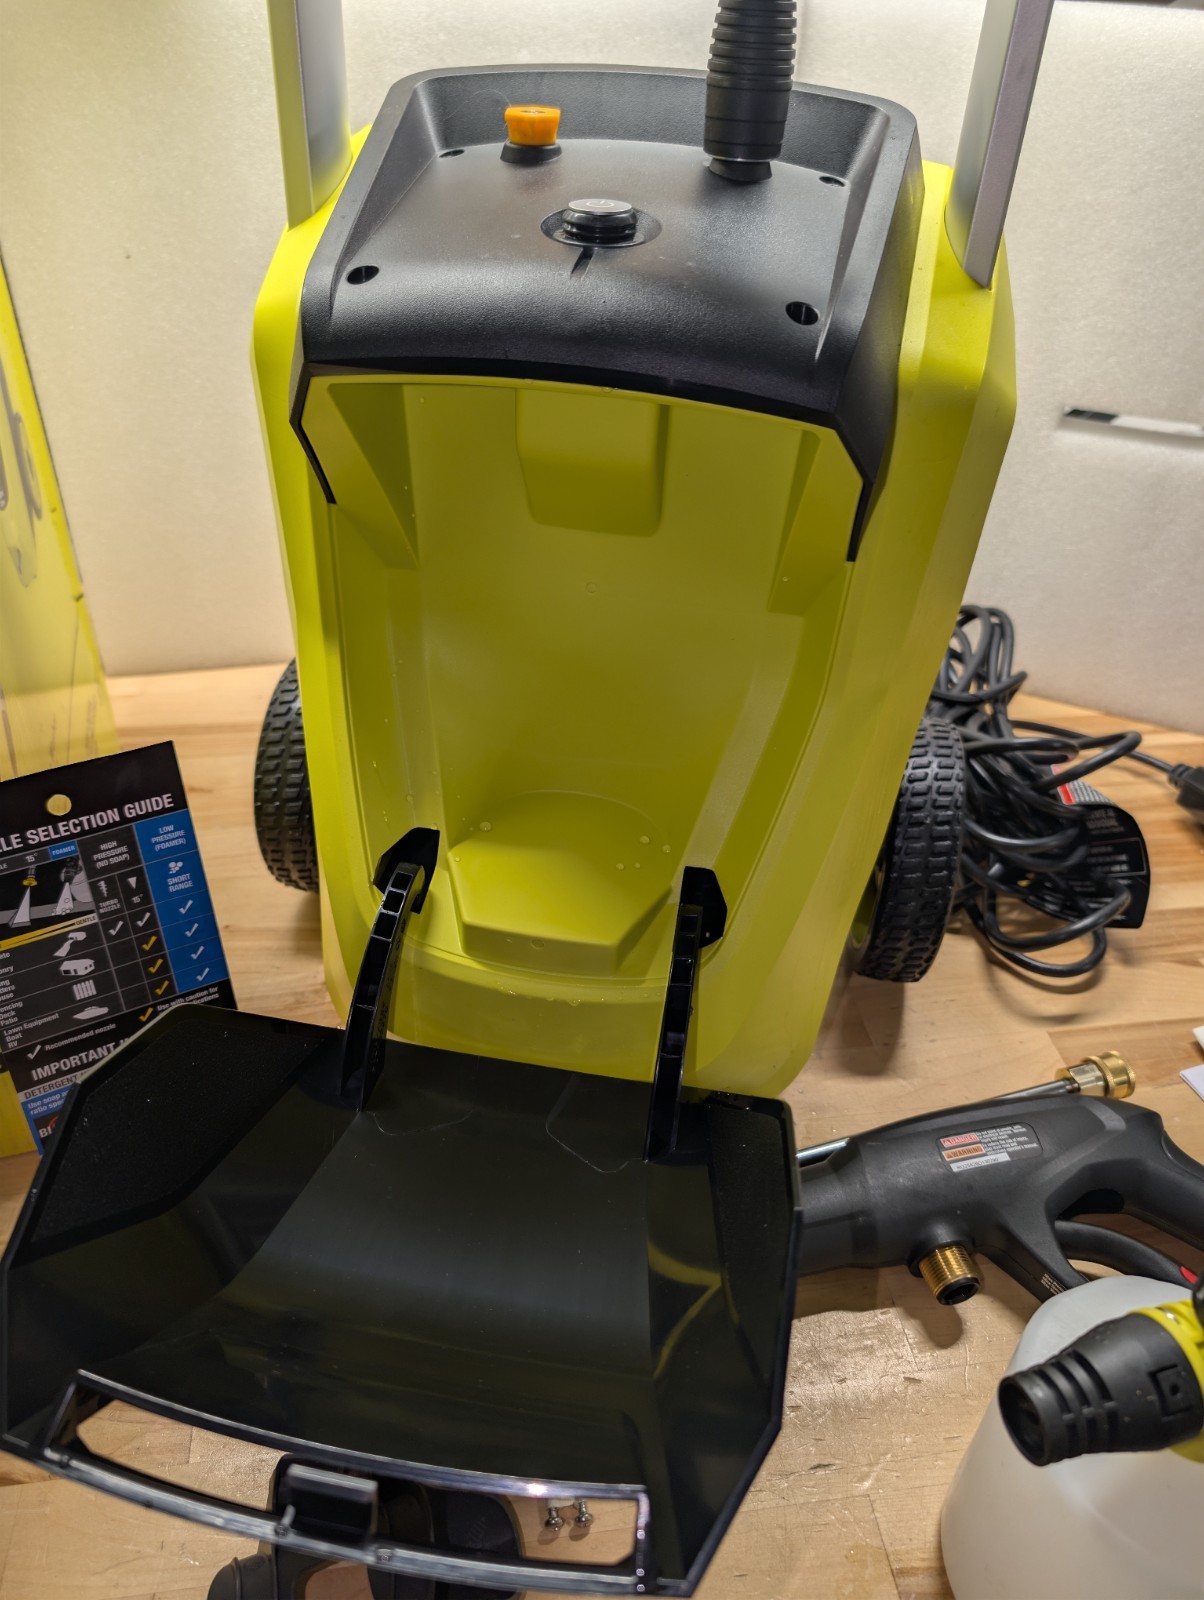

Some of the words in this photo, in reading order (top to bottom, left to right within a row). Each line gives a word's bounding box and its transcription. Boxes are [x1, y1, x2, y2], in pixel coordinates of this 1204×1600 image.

[0, 834, 23, 852] LE
[26, 808, 121, 844] SELECTION
[123, 793, 174, 818] GUIDE
[158, 825, 174, 834] LOW
[151, 830, 186, 843] PRESSURE
[52, 845, 75, 856] FOAMER
[100, 841, 117, 850] HIGH
[155, 838, 186, 851] (FOAMER)
[93, 846, 128, 860] PRESSURE
[96, 859, 109, 869] (NO
[168, 873, 191, 885] SHORT
[169, 881, 193, 892] RANGE
[4, 1025, 22, 1036] Lawn
[24, 1013, 59, 1029] Equipment
[6, 1032, 23, 1042] Boat
[45, 1028, 94, 1051] Recommended
[95, 1023, 116, 1034] nozzle
[8, 1040, 18, 1049] RV
[31, 1042, 115, 1080] IMPORTANT
[24, 1075, 78, 1099] DETERGENT
